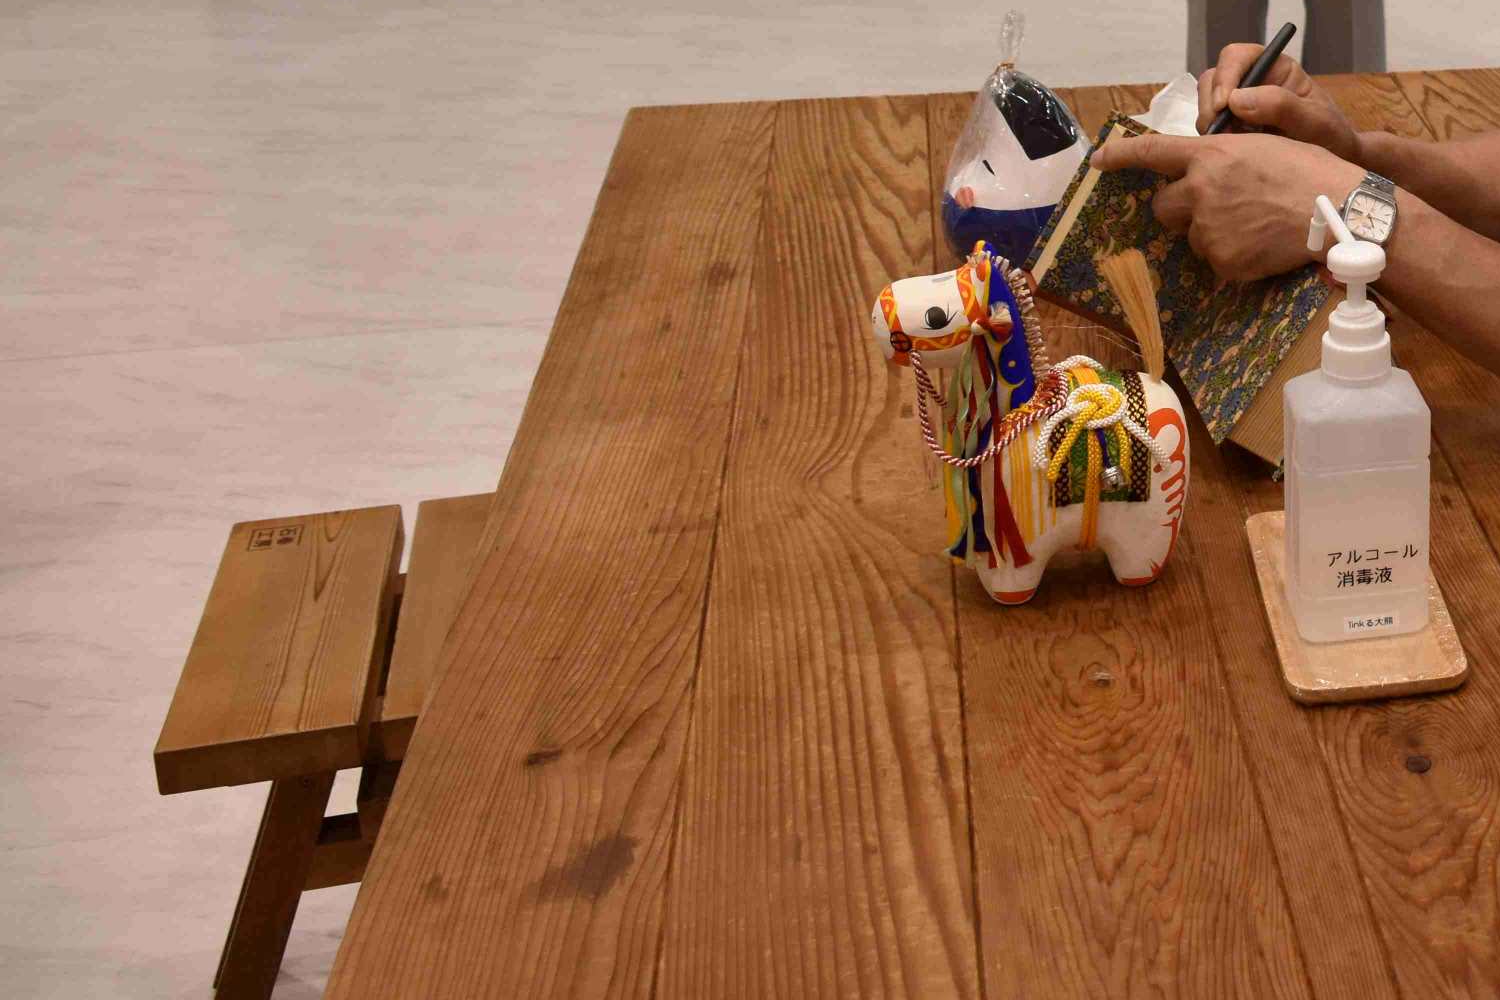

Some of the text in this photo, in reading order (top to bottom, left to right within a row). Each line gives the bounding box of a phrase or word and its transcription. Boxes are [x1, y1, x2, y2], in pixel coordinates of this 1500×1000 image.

[1327, 544, 1419, 567] アルコール
[1337, 566, 1393, 588] 消毒液
